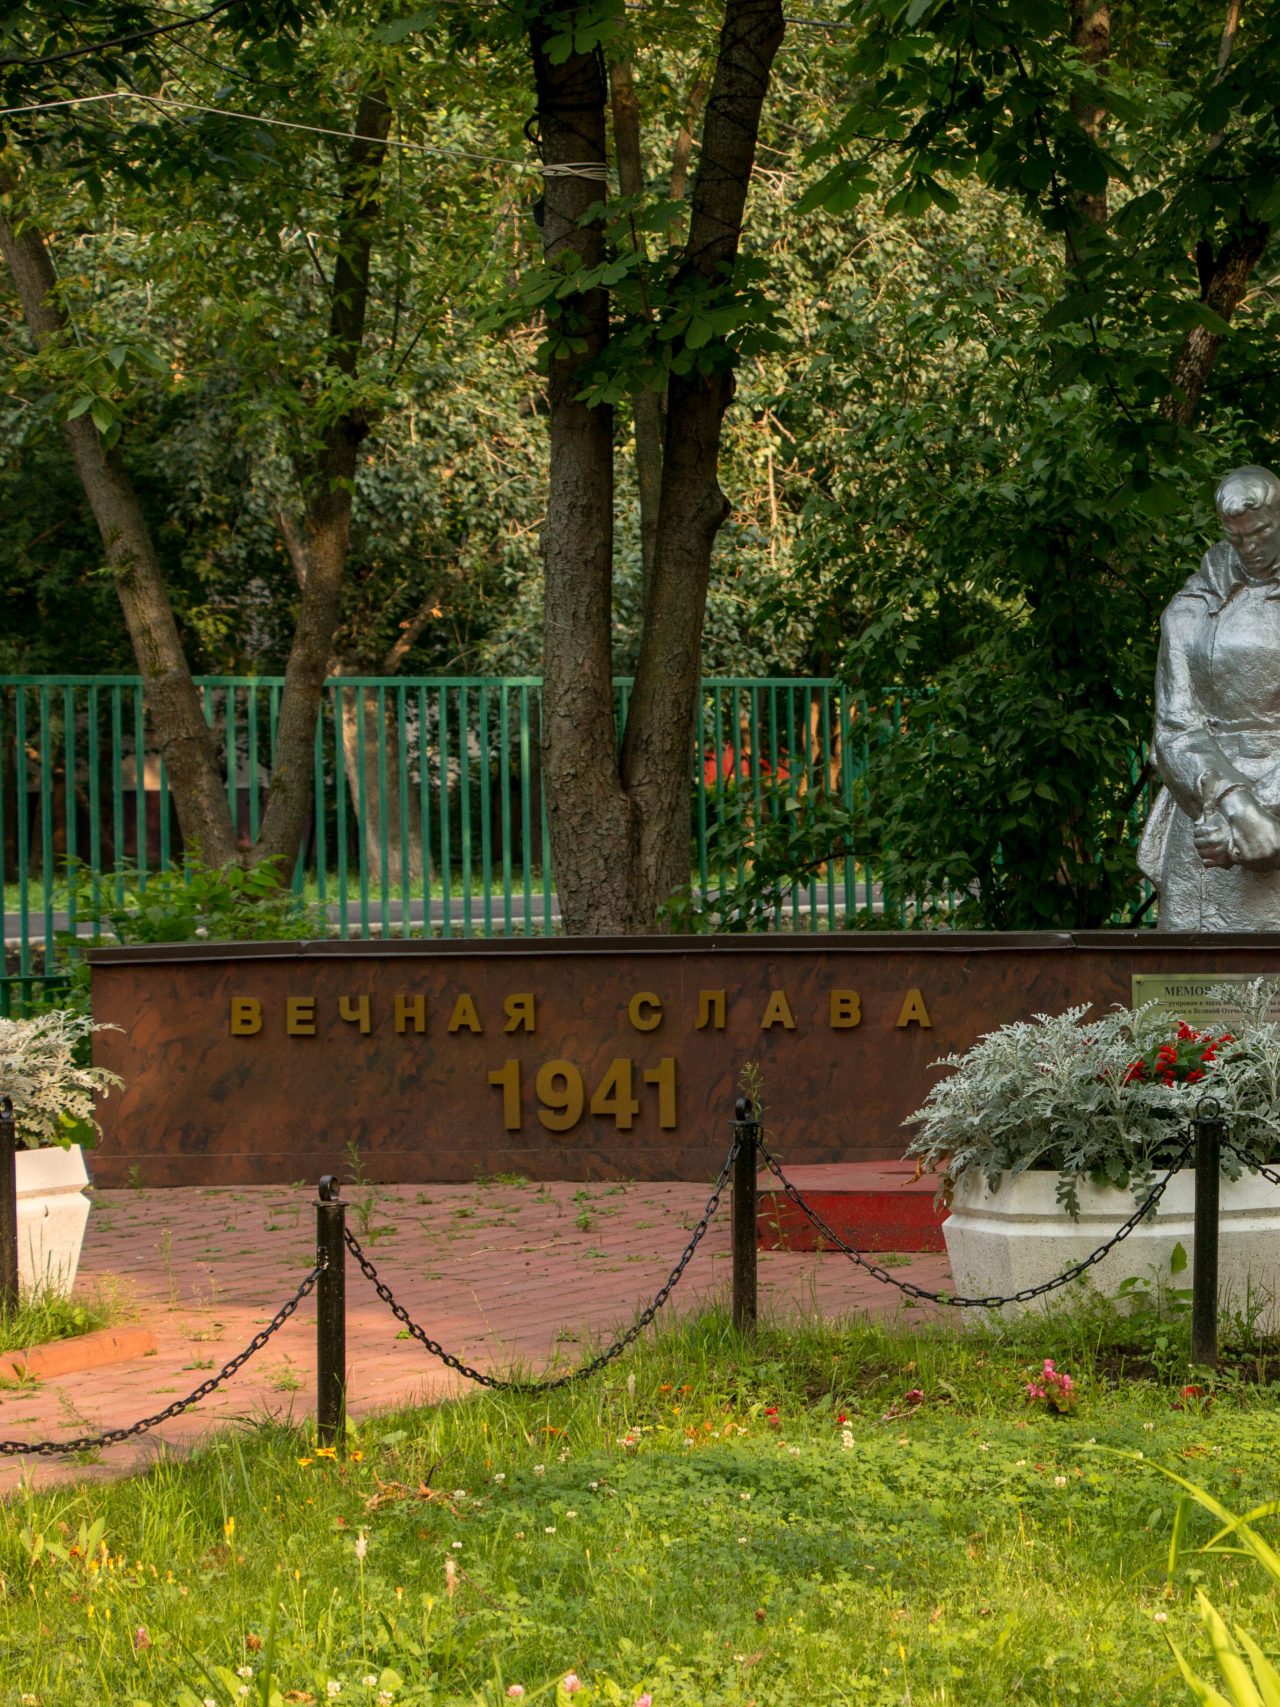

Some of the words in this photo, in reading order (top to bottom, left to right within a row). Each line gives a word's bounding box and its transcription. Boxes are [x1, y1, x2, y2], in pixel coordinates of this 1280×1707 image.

[230, 991, 536, 1036] ВЕЧНАЯ
[628, 988, 932, 1032] СЛАВА
[488, 1057, 678, 1132] 1941
